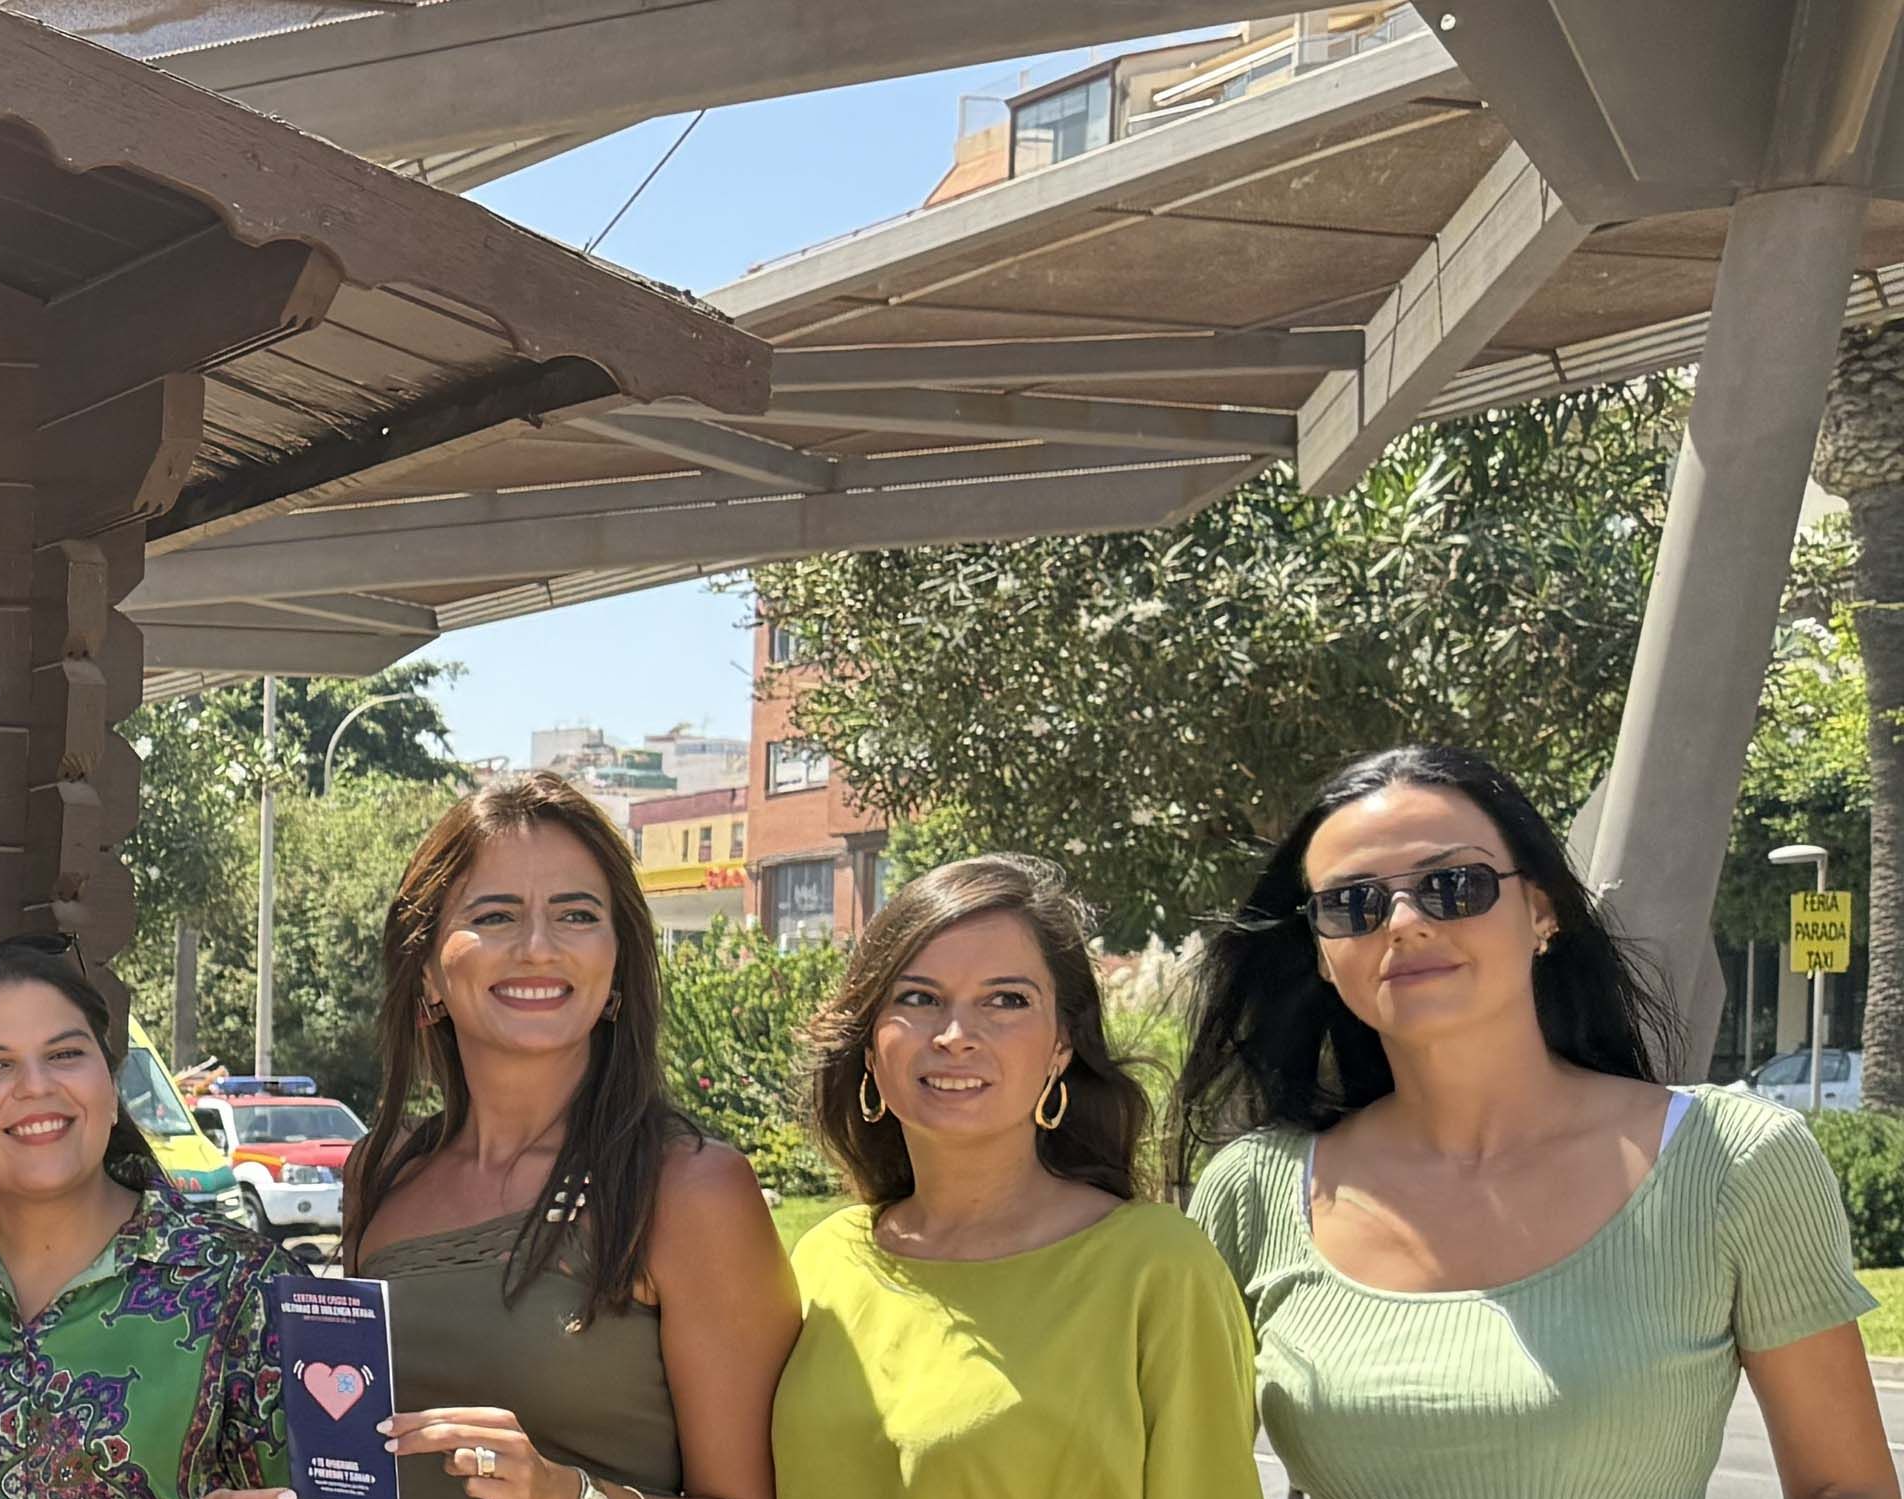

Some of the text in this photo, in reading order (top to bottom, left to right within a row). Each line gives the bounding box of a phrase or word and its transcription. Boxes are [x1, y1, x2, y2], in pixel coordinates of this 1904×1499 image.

[1802, 893, 1840, 913] FERIA
[1795, 923, 1847, 941] PARADA
[1806, 951, 1833, 970] TAXI
